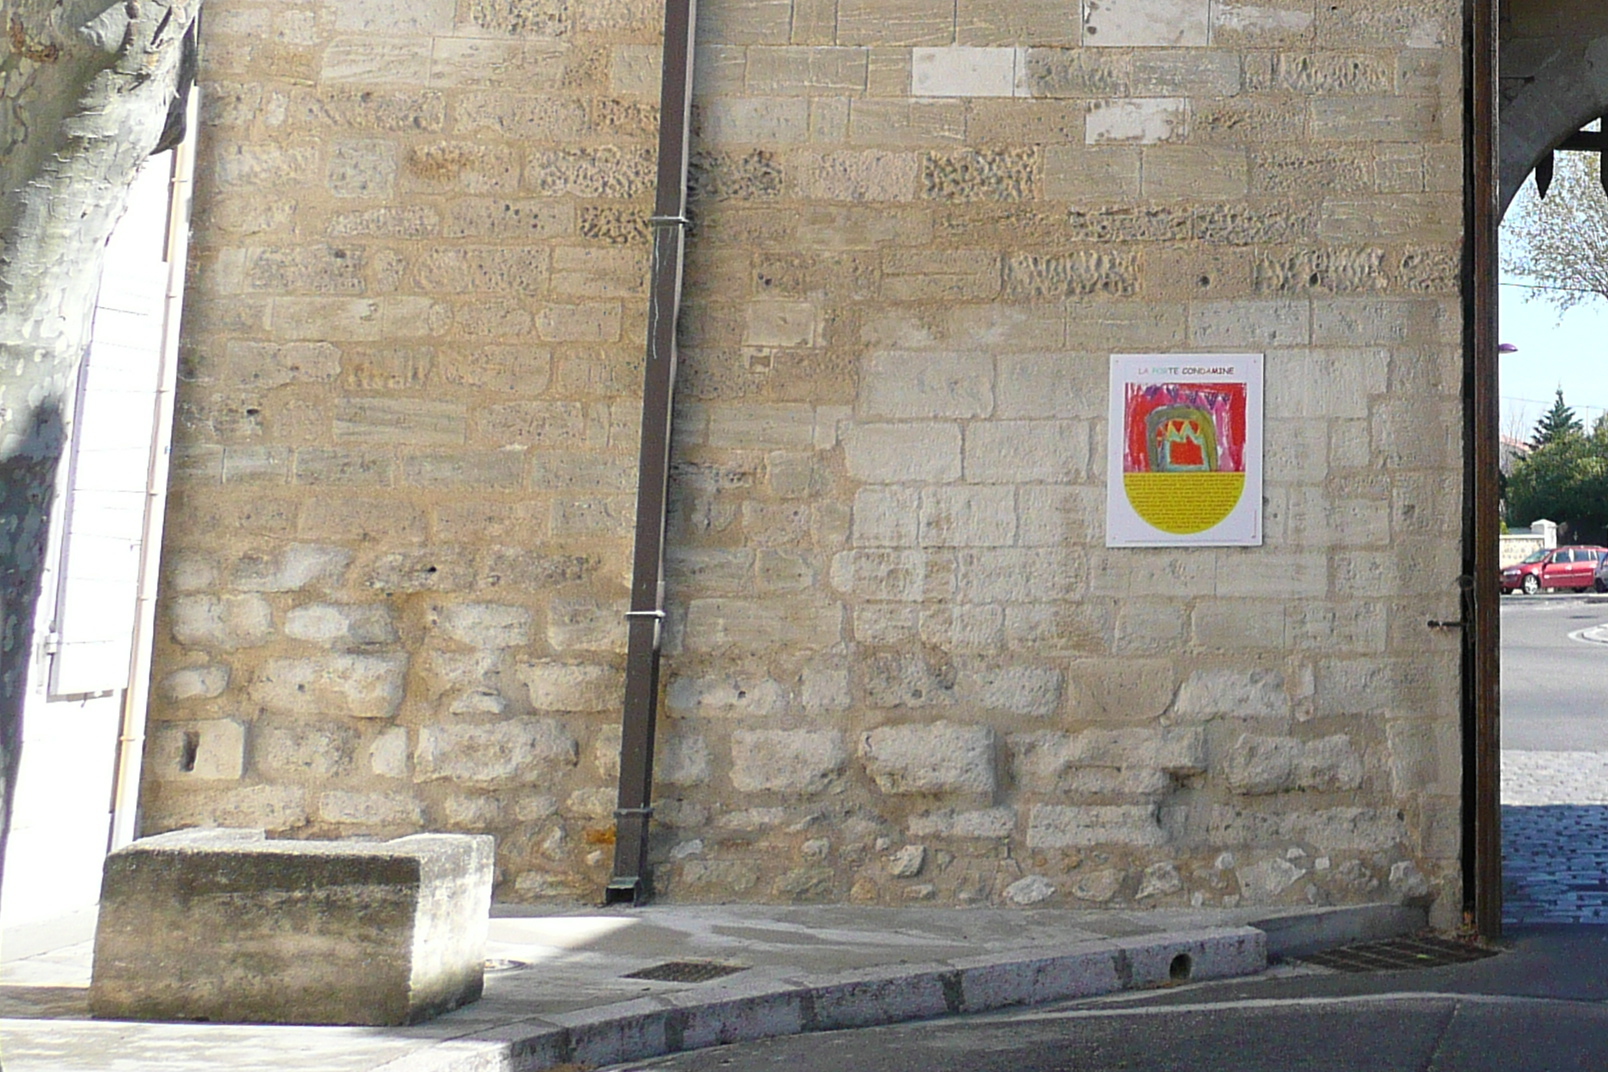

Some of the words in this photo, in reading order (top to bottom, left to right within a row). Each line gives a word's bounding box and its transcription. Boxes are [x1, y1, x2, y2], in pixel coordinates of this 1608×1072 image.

[1138, 367, 1149, 375] LA
[1151, 367, 1179, 375] PORTE
[1182, 367, 1235, 375] CONDAMINE
